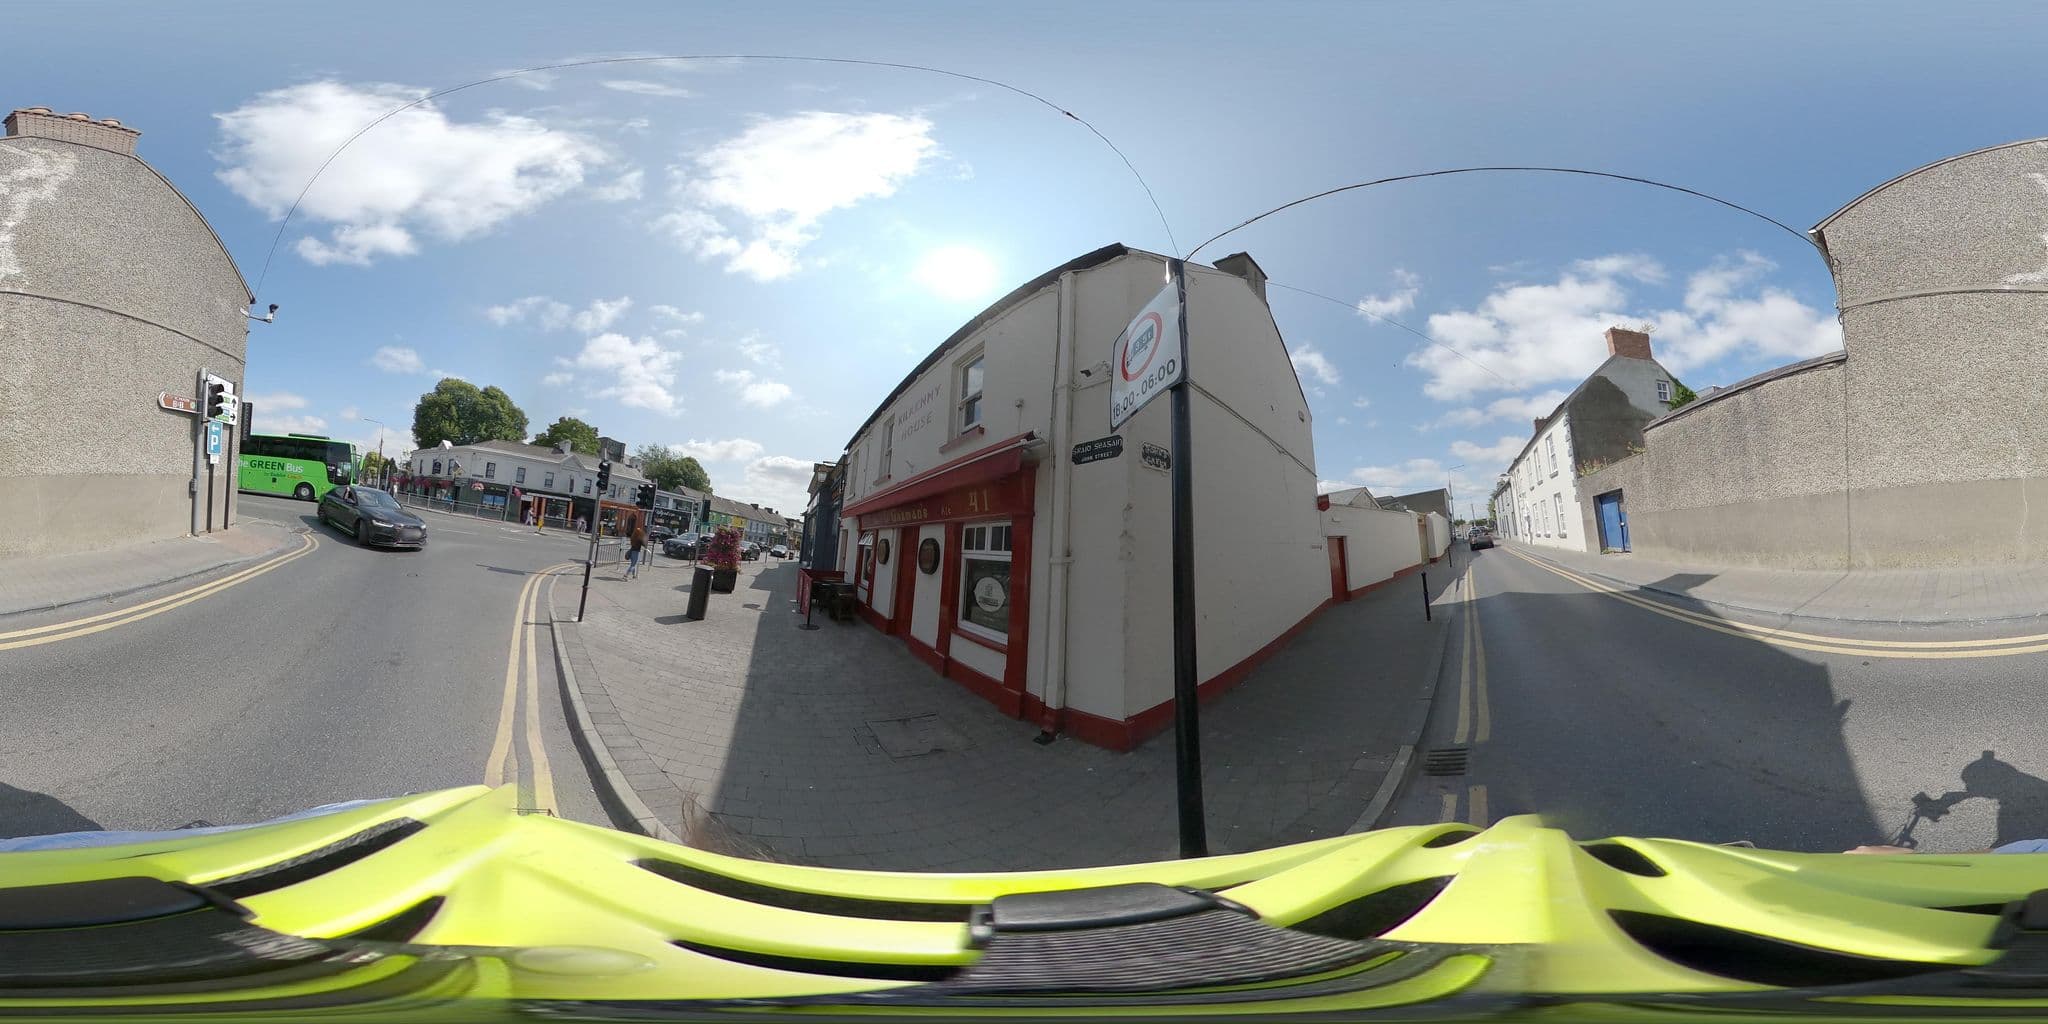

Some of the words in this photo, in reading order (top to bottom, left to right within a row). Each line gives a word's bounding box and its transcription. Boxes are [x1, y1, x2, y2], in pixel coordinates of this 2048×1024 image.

[1113, 391, 1135, 420] 18:00
[1141, 358, 1176, 395] 06:00
[898, 384, 942, 426] KILKENNY
[901, 410, 932, 440] HOUSE
[211, 434, 219, 451] P
[250, 459, 285, 471] GREEN
[286, 462, 304, 473] Bus
[1094, 451, 1113, 460] STREET
